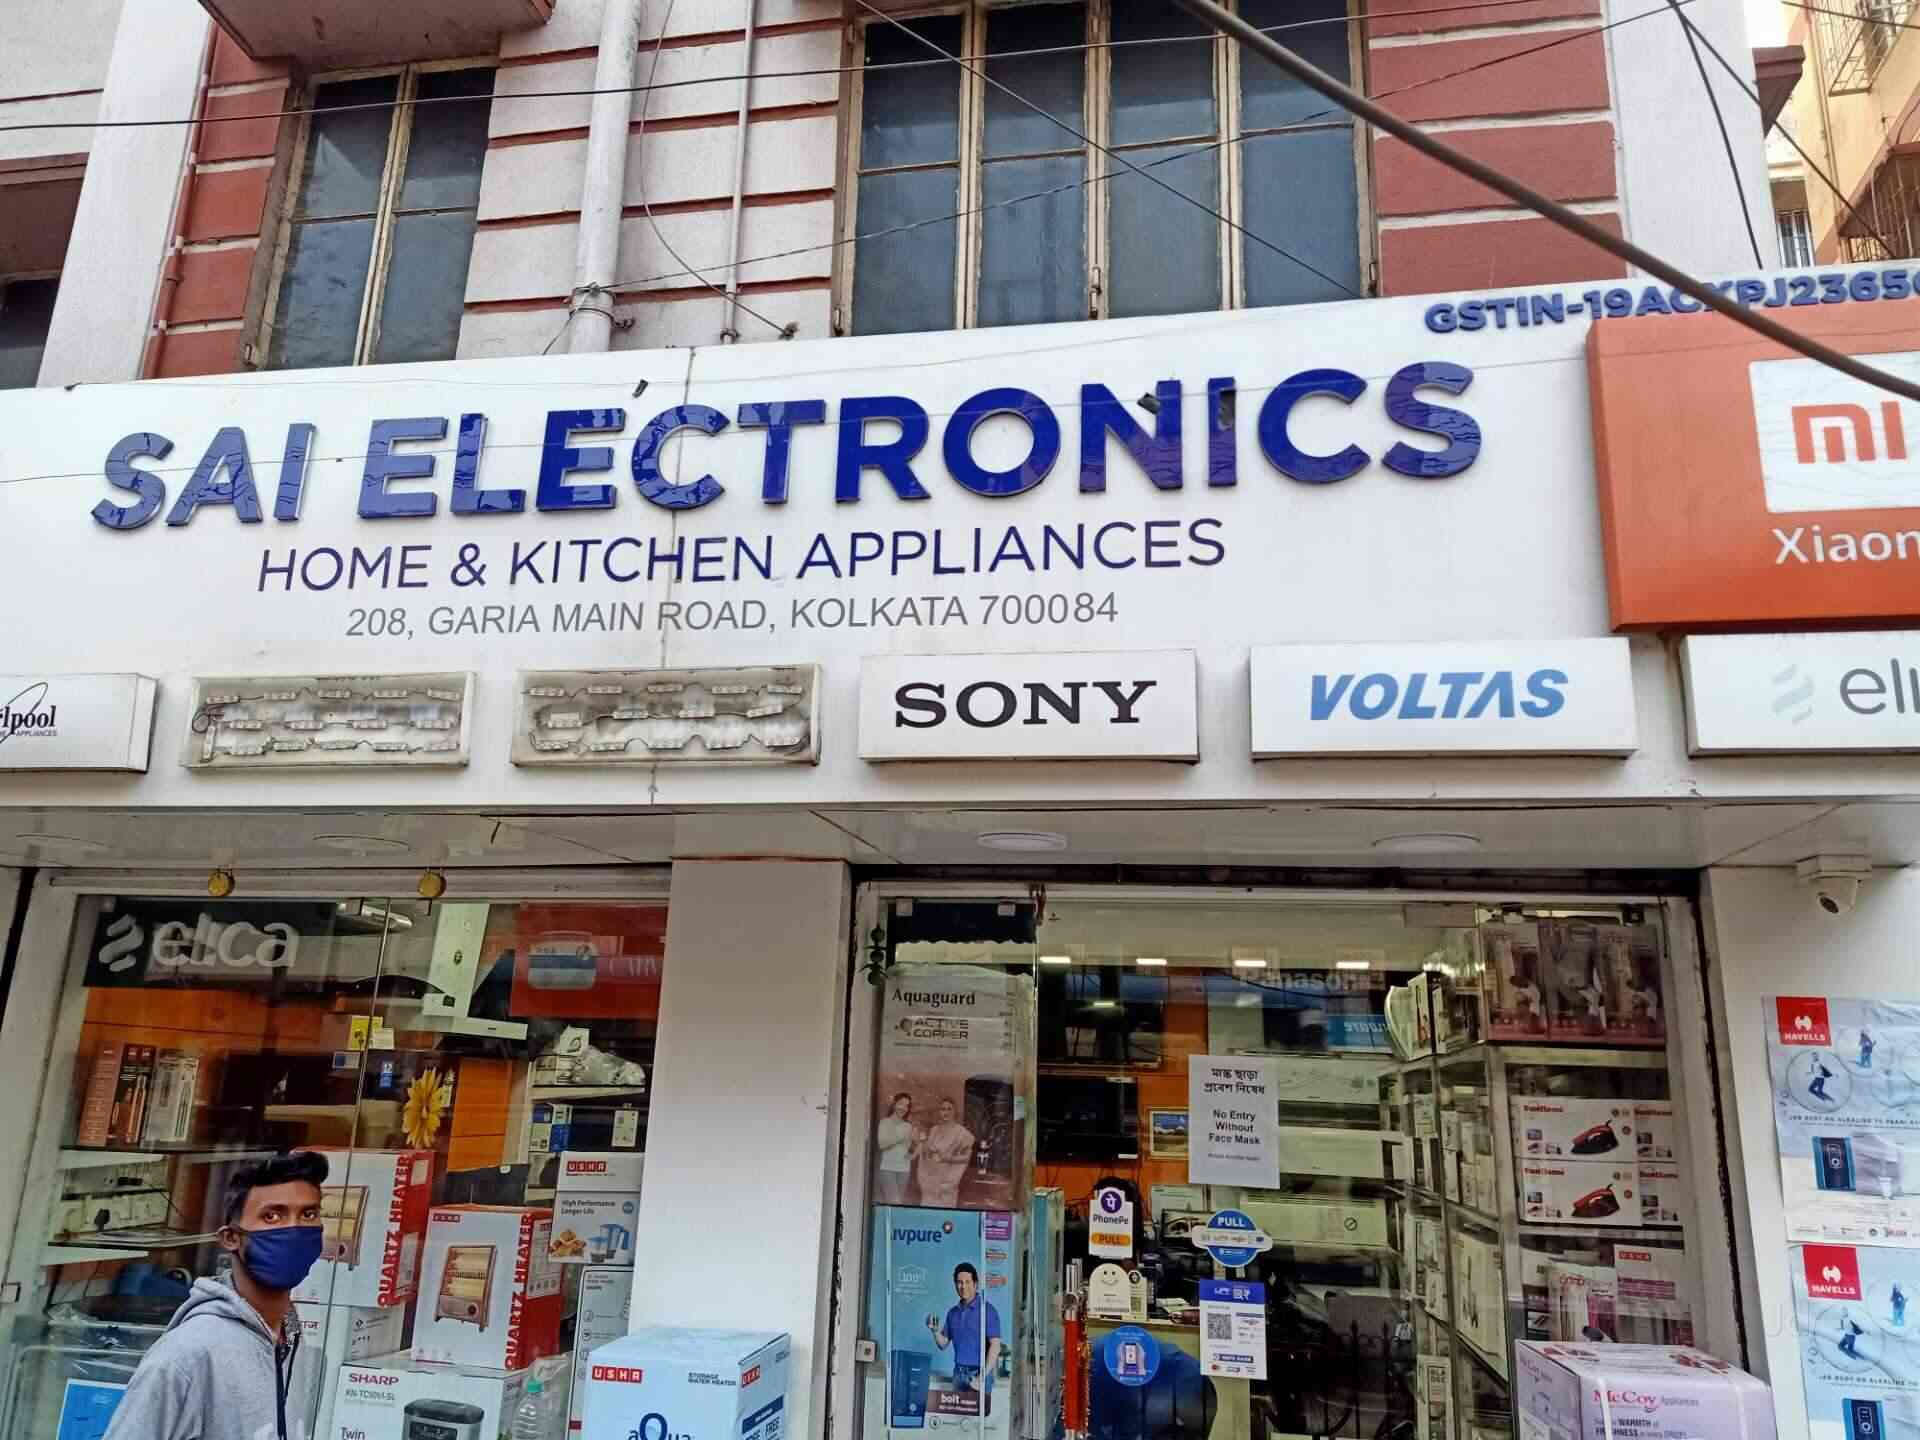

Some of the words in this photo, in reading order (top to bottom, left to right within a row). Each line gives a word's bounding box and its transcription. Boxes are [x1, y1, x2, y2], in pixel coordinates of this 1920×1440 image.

[90, 423, 316, 530] SAI
[358, 361, 1482, 520] ELECTRONICS
[257, 544, 433, 592] HOME
[450, 542, 487, 587] &
[508, 535, 772, 586] KITCHEN
[796, 517, 1226, 579] APPLIANCES
[345, 607, 415, 640] 208,
[427, 603, 541, 636] GARIA
[551, 601, 645, 634] MAIN
[656, 599, 776, 632] ROAD,
[790, 596, 968, 629] KOLKATA
[979, 591, 1119, 627] 700084
[1309, 668, 1569, 720] VOLTAS
[894, 680, 1157, 728] SONY
[891, 988, 976, 1008] Aquaguard
[913, 1017, 969, 1029] ACTIVE
[912, 1028, 969, 1040] COPPER
[1784, 1032, 1826, 1042] HAVELLS
[1213, 1109, 1228, 1119] No
[1230, 1110, 1256, 1122] Entry
[1215, 1121, 1254, 1133] Without
[1208, 1132, 1233, 1143] Face
[1234, 1134, 1261, 1145] Mask
[566, 1160, 608, 1173] USHA
[388, 1152, 411, 1223] HEATER
[561, 1200, 578, 1208] High
[1092, 1213, 1129, 1225] PhonePe
[1218, 1216, 1246, 1228] PULL
[1099, 1235, 1121, 1246] PULL
[377, 1231, 402, 1308] QUARTZ
[504, 1291, 524, 1370] QUARTZ
[514, 1212, 535, 1284] HEATER
[1811, 1284, 1857, 1296] HAVELLS
[348, 1372, 400, 1386] SHARP
[591, 1366, 643, 1384] USHA
[688, 1378, 711, 1386] WATER
[941, 1392, 960, 1404] bolt
[341, 1427, 366, 1440] Twin
